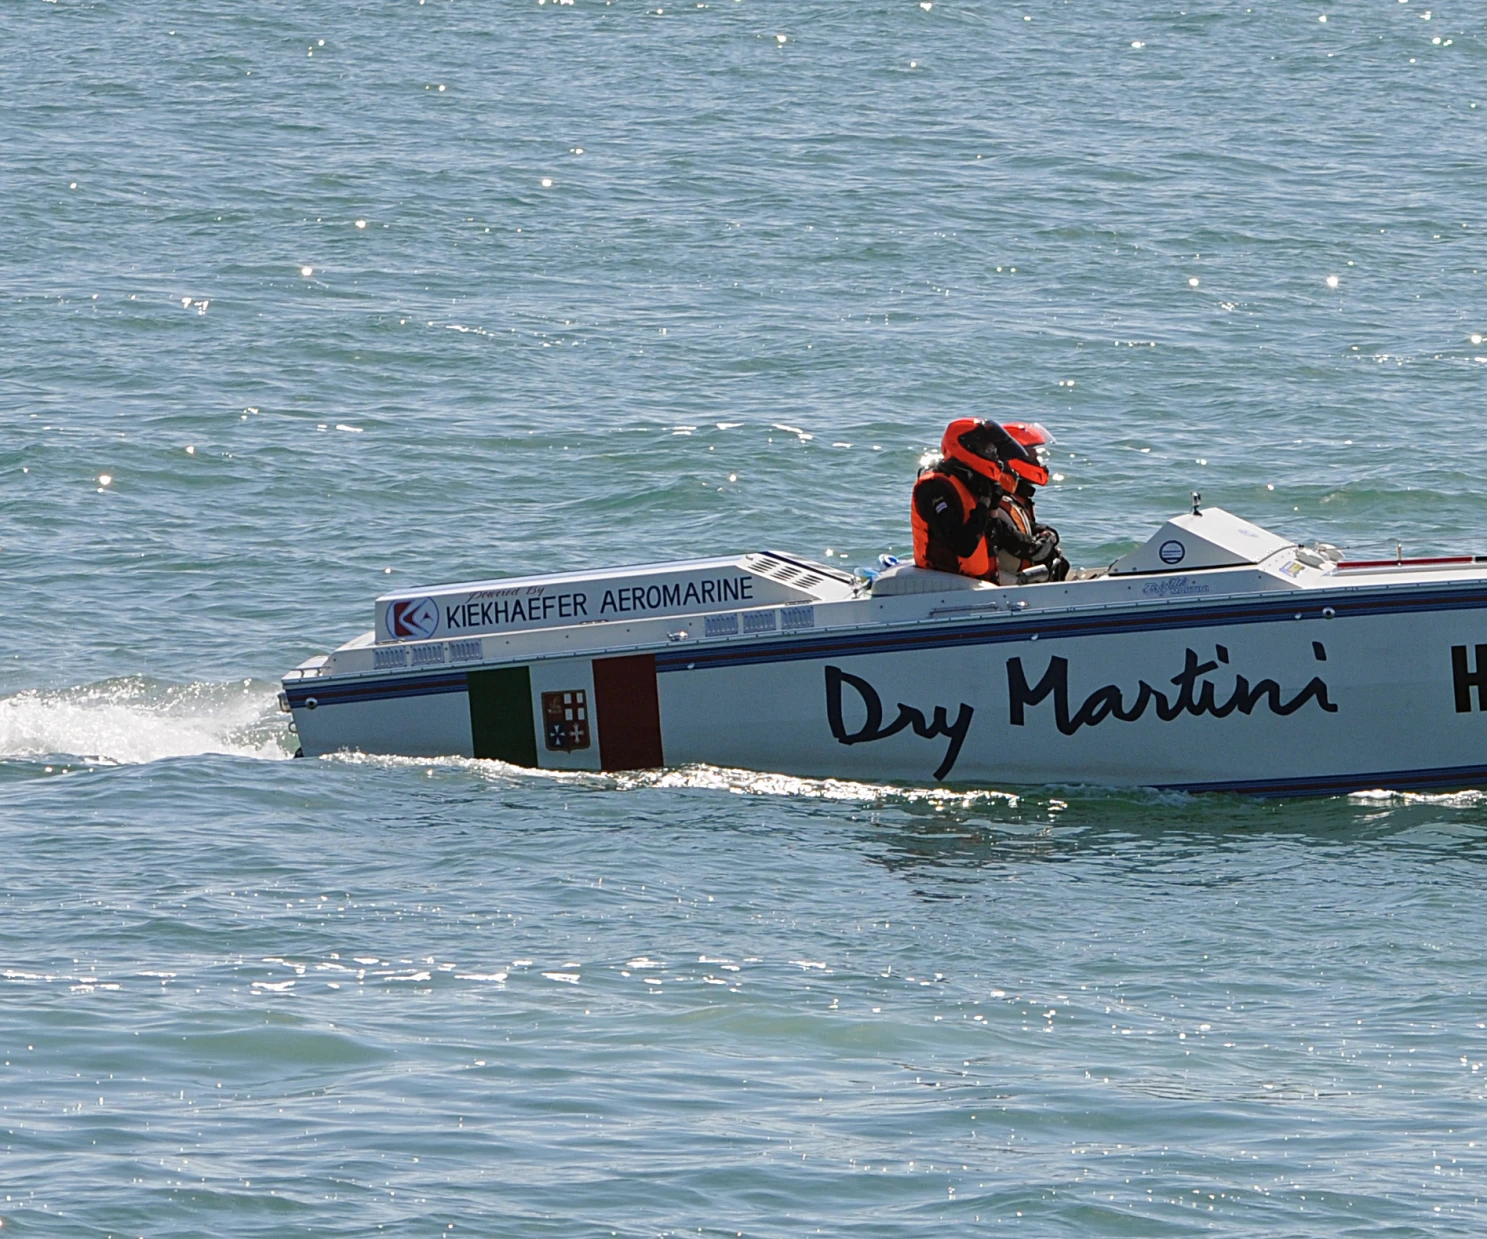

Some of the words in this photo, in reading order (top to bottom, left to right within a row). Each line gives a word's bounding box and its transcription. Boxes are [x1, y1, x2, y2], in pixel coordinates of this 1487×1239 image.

[446, 592, 589, 629] KIEKHAEFER
[600, 576, 754, 614] AEROMARINE
[466, 587, 520, 604] Powered
[526, 586, 545, 597] By
[824, 664, 975, 781] Dry
[1006, 641, 1338, 736] Martini
